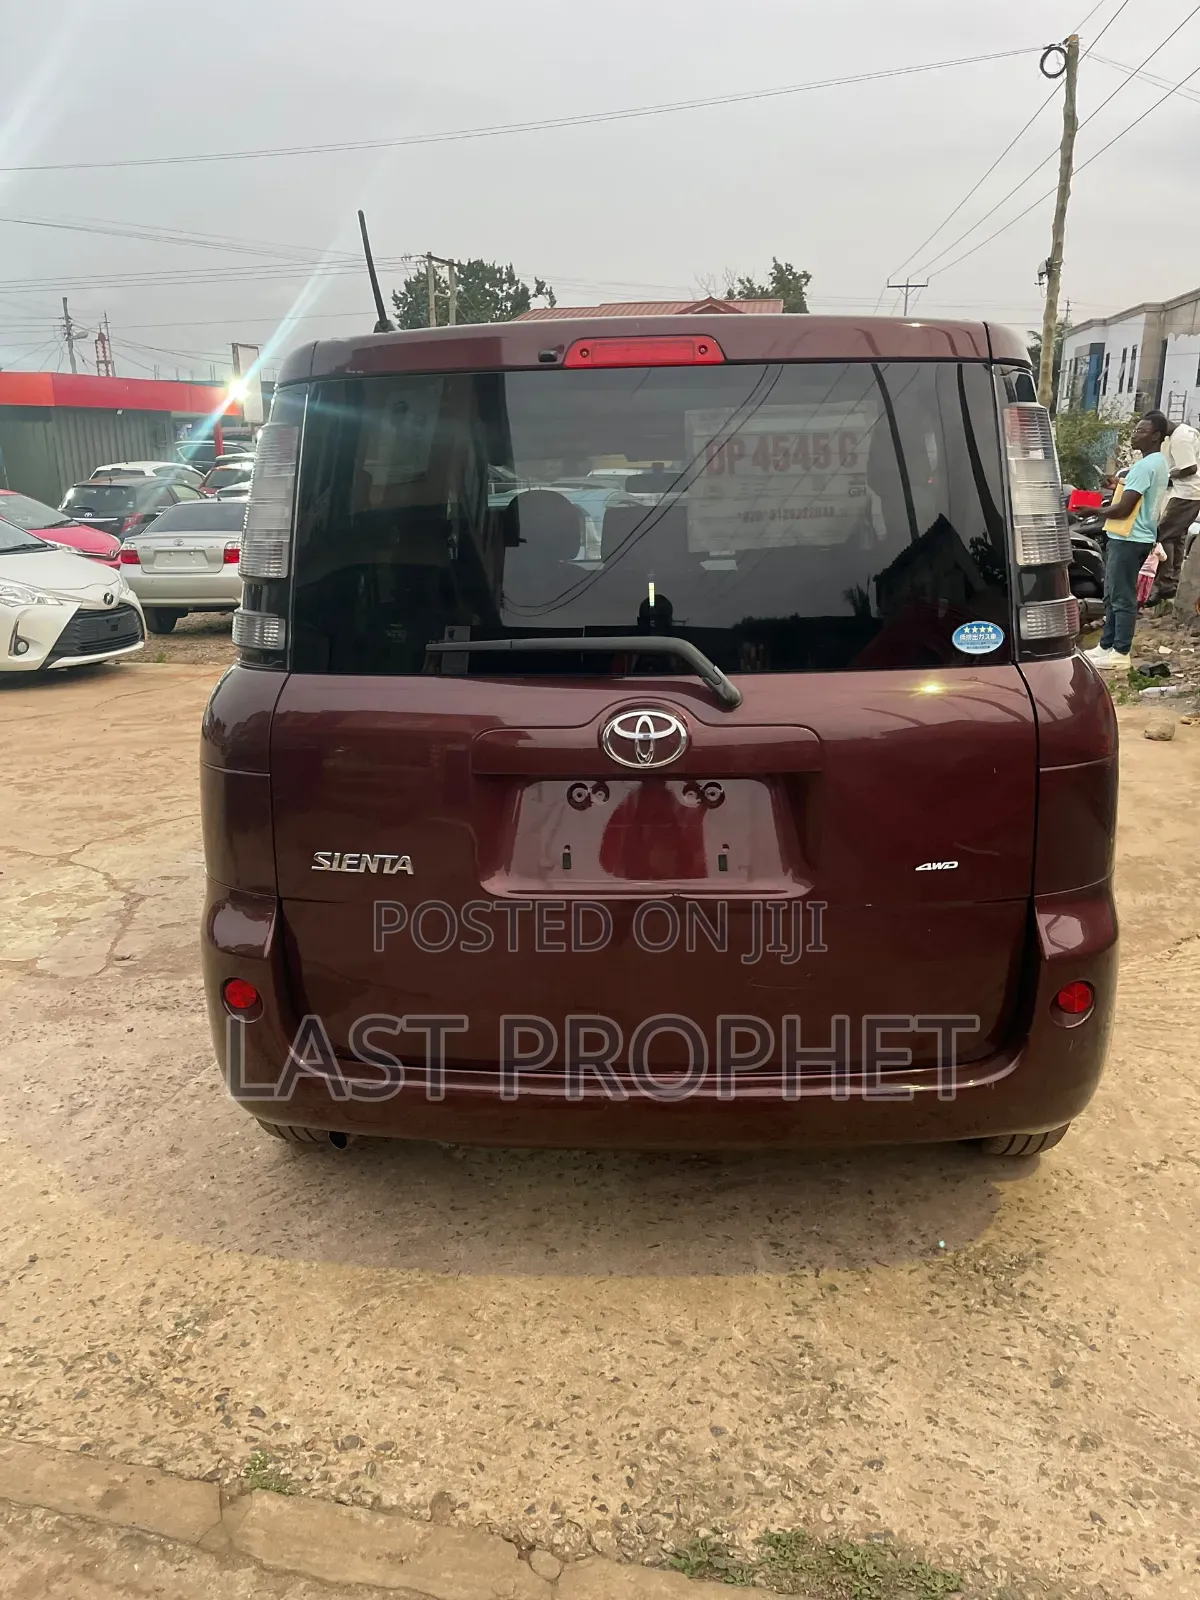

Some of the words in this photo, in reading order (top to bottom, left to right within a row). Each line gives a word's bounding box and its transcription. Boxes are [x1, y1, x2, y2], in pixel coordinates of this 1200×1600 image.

[752, 434, 832, 472] 4545
[311, 851, 414, 875] SIENTA
[915, 861, 959, 871] 4WD
